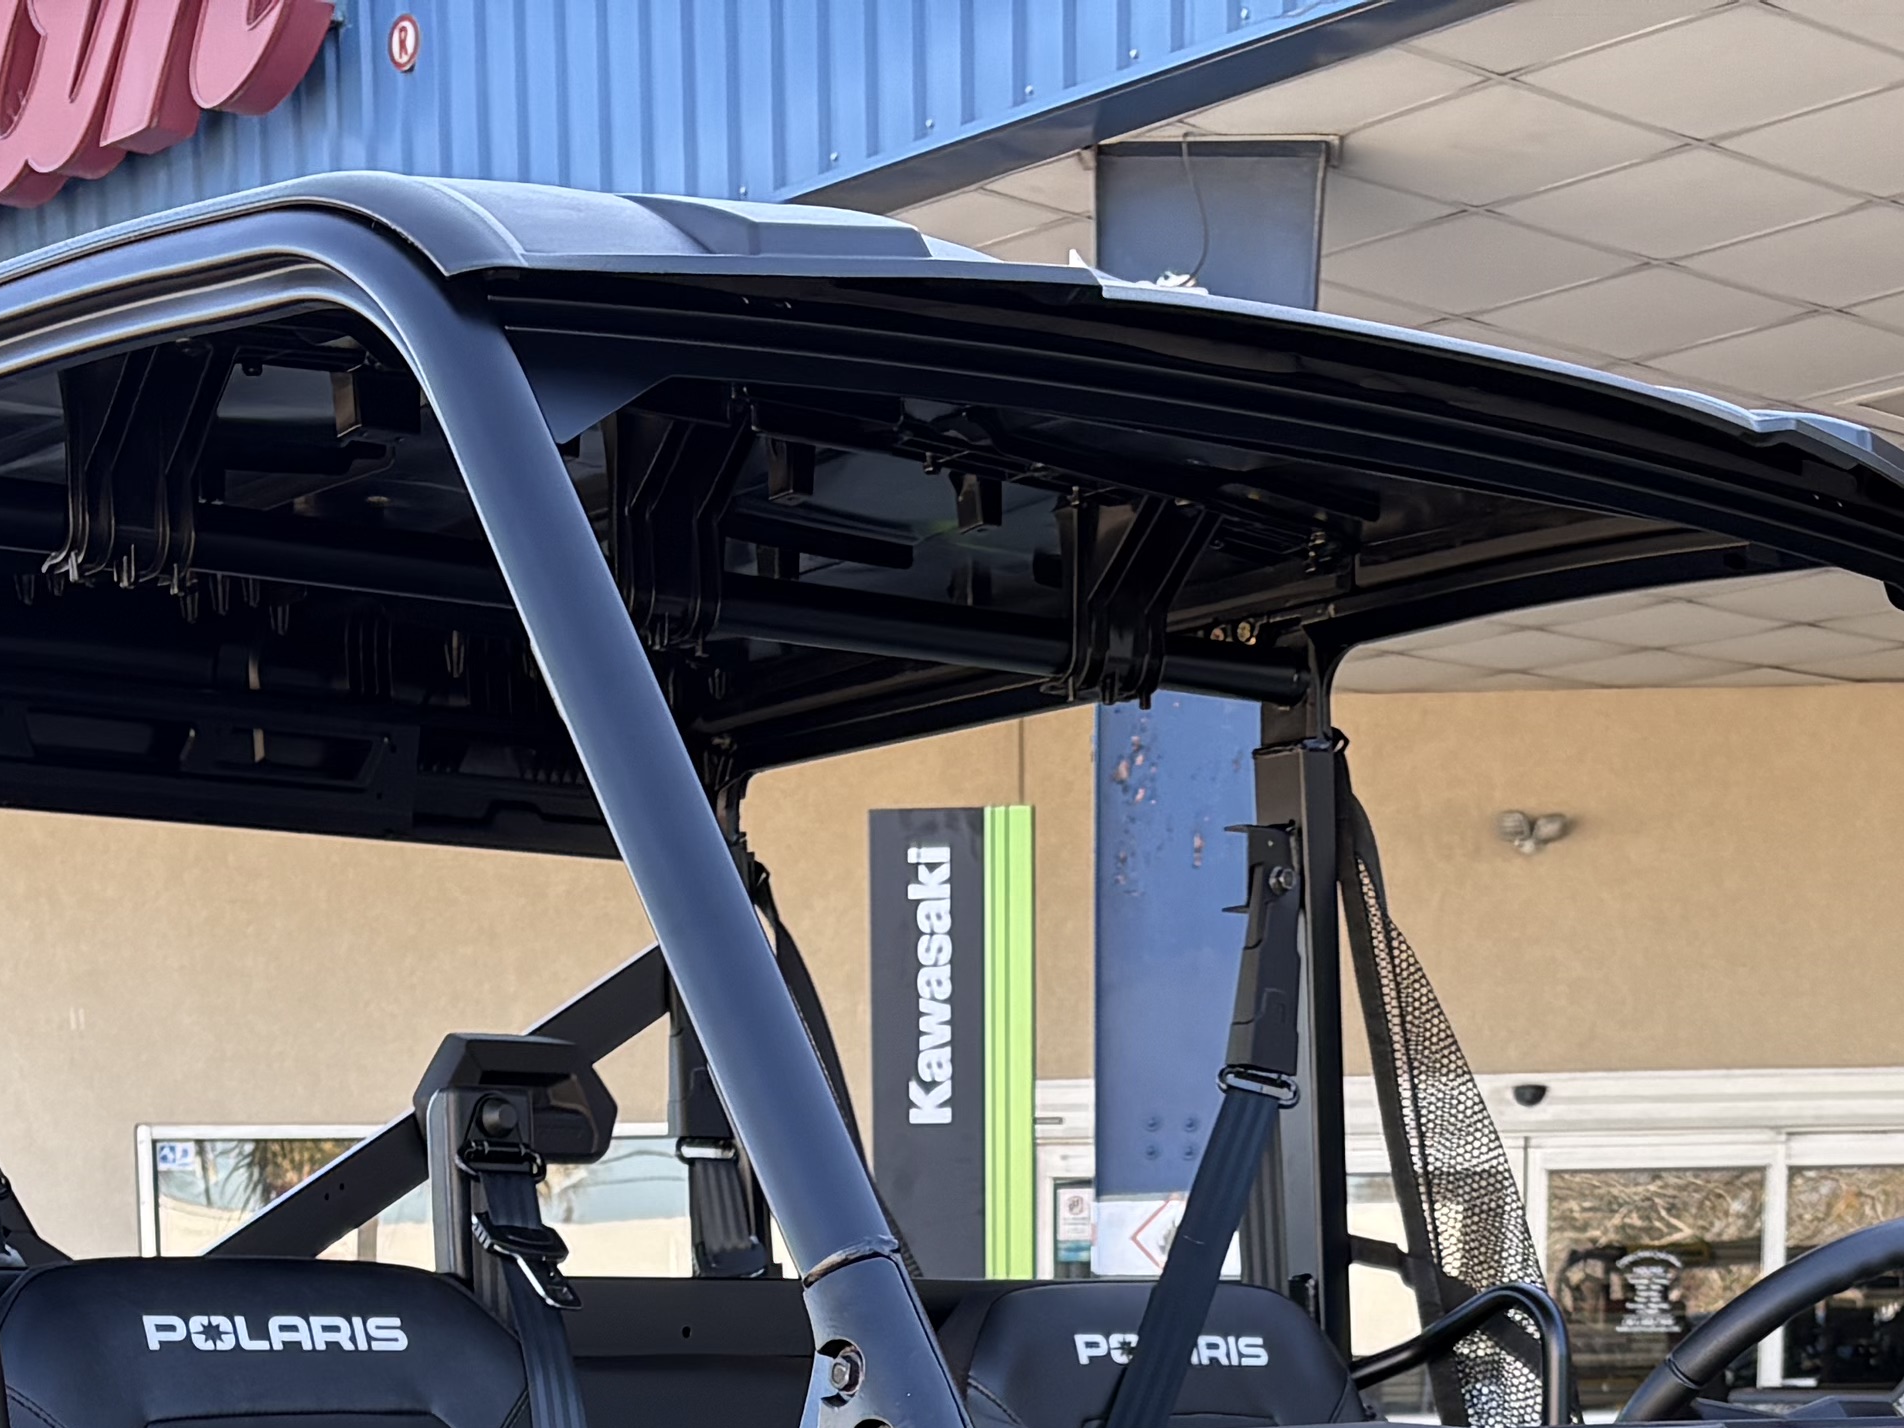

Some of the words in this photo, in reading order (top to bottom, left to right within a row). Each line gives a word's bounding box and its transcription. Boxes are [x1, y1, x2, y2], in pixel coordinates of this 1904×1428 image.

[907, 846, 953, 1124] Kawasaki
[142, 1314, 408, 1351] POLARIS
[1074, 1333, 1269, 1367] PORIS
